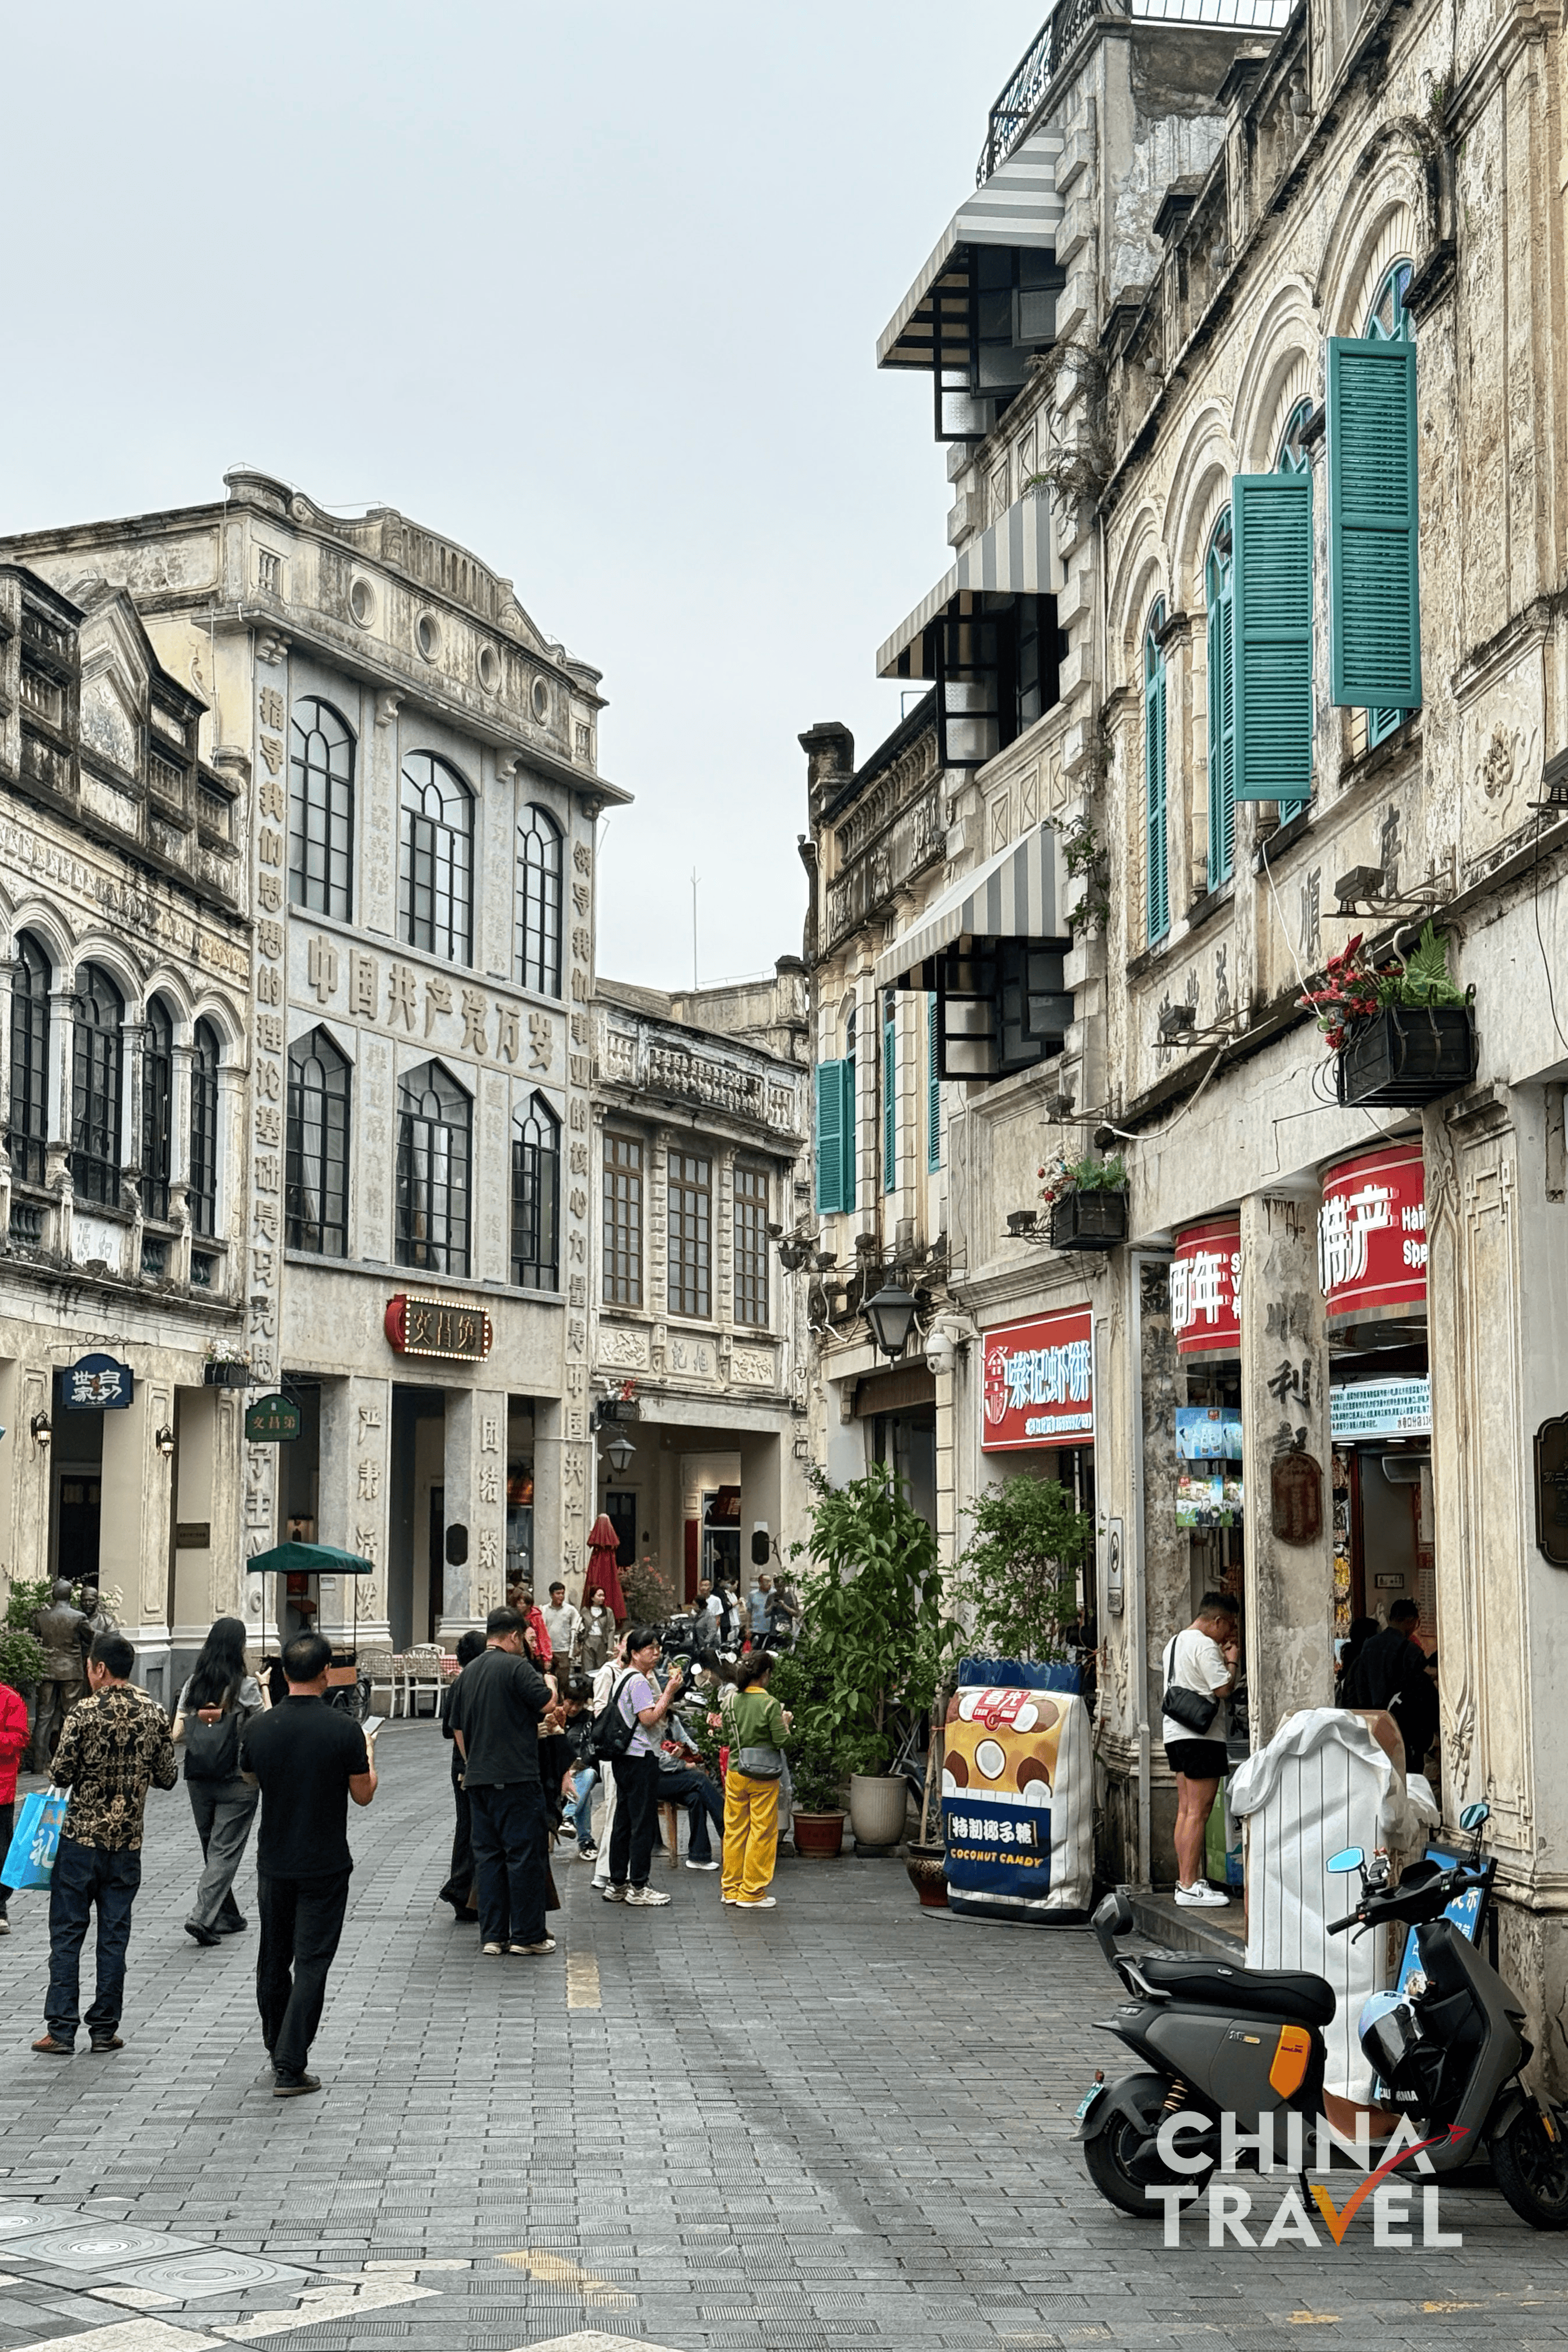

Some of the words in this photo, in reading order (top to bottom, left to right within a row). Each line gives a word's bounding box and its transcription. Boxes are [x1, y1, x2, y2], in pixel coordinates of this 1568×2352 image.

[308, 935, 554, 1071] 中国共产党万岁
[950, 1849, 998, 1862] COCONUT
[999, 1853, 1044, 1868] CANDY
